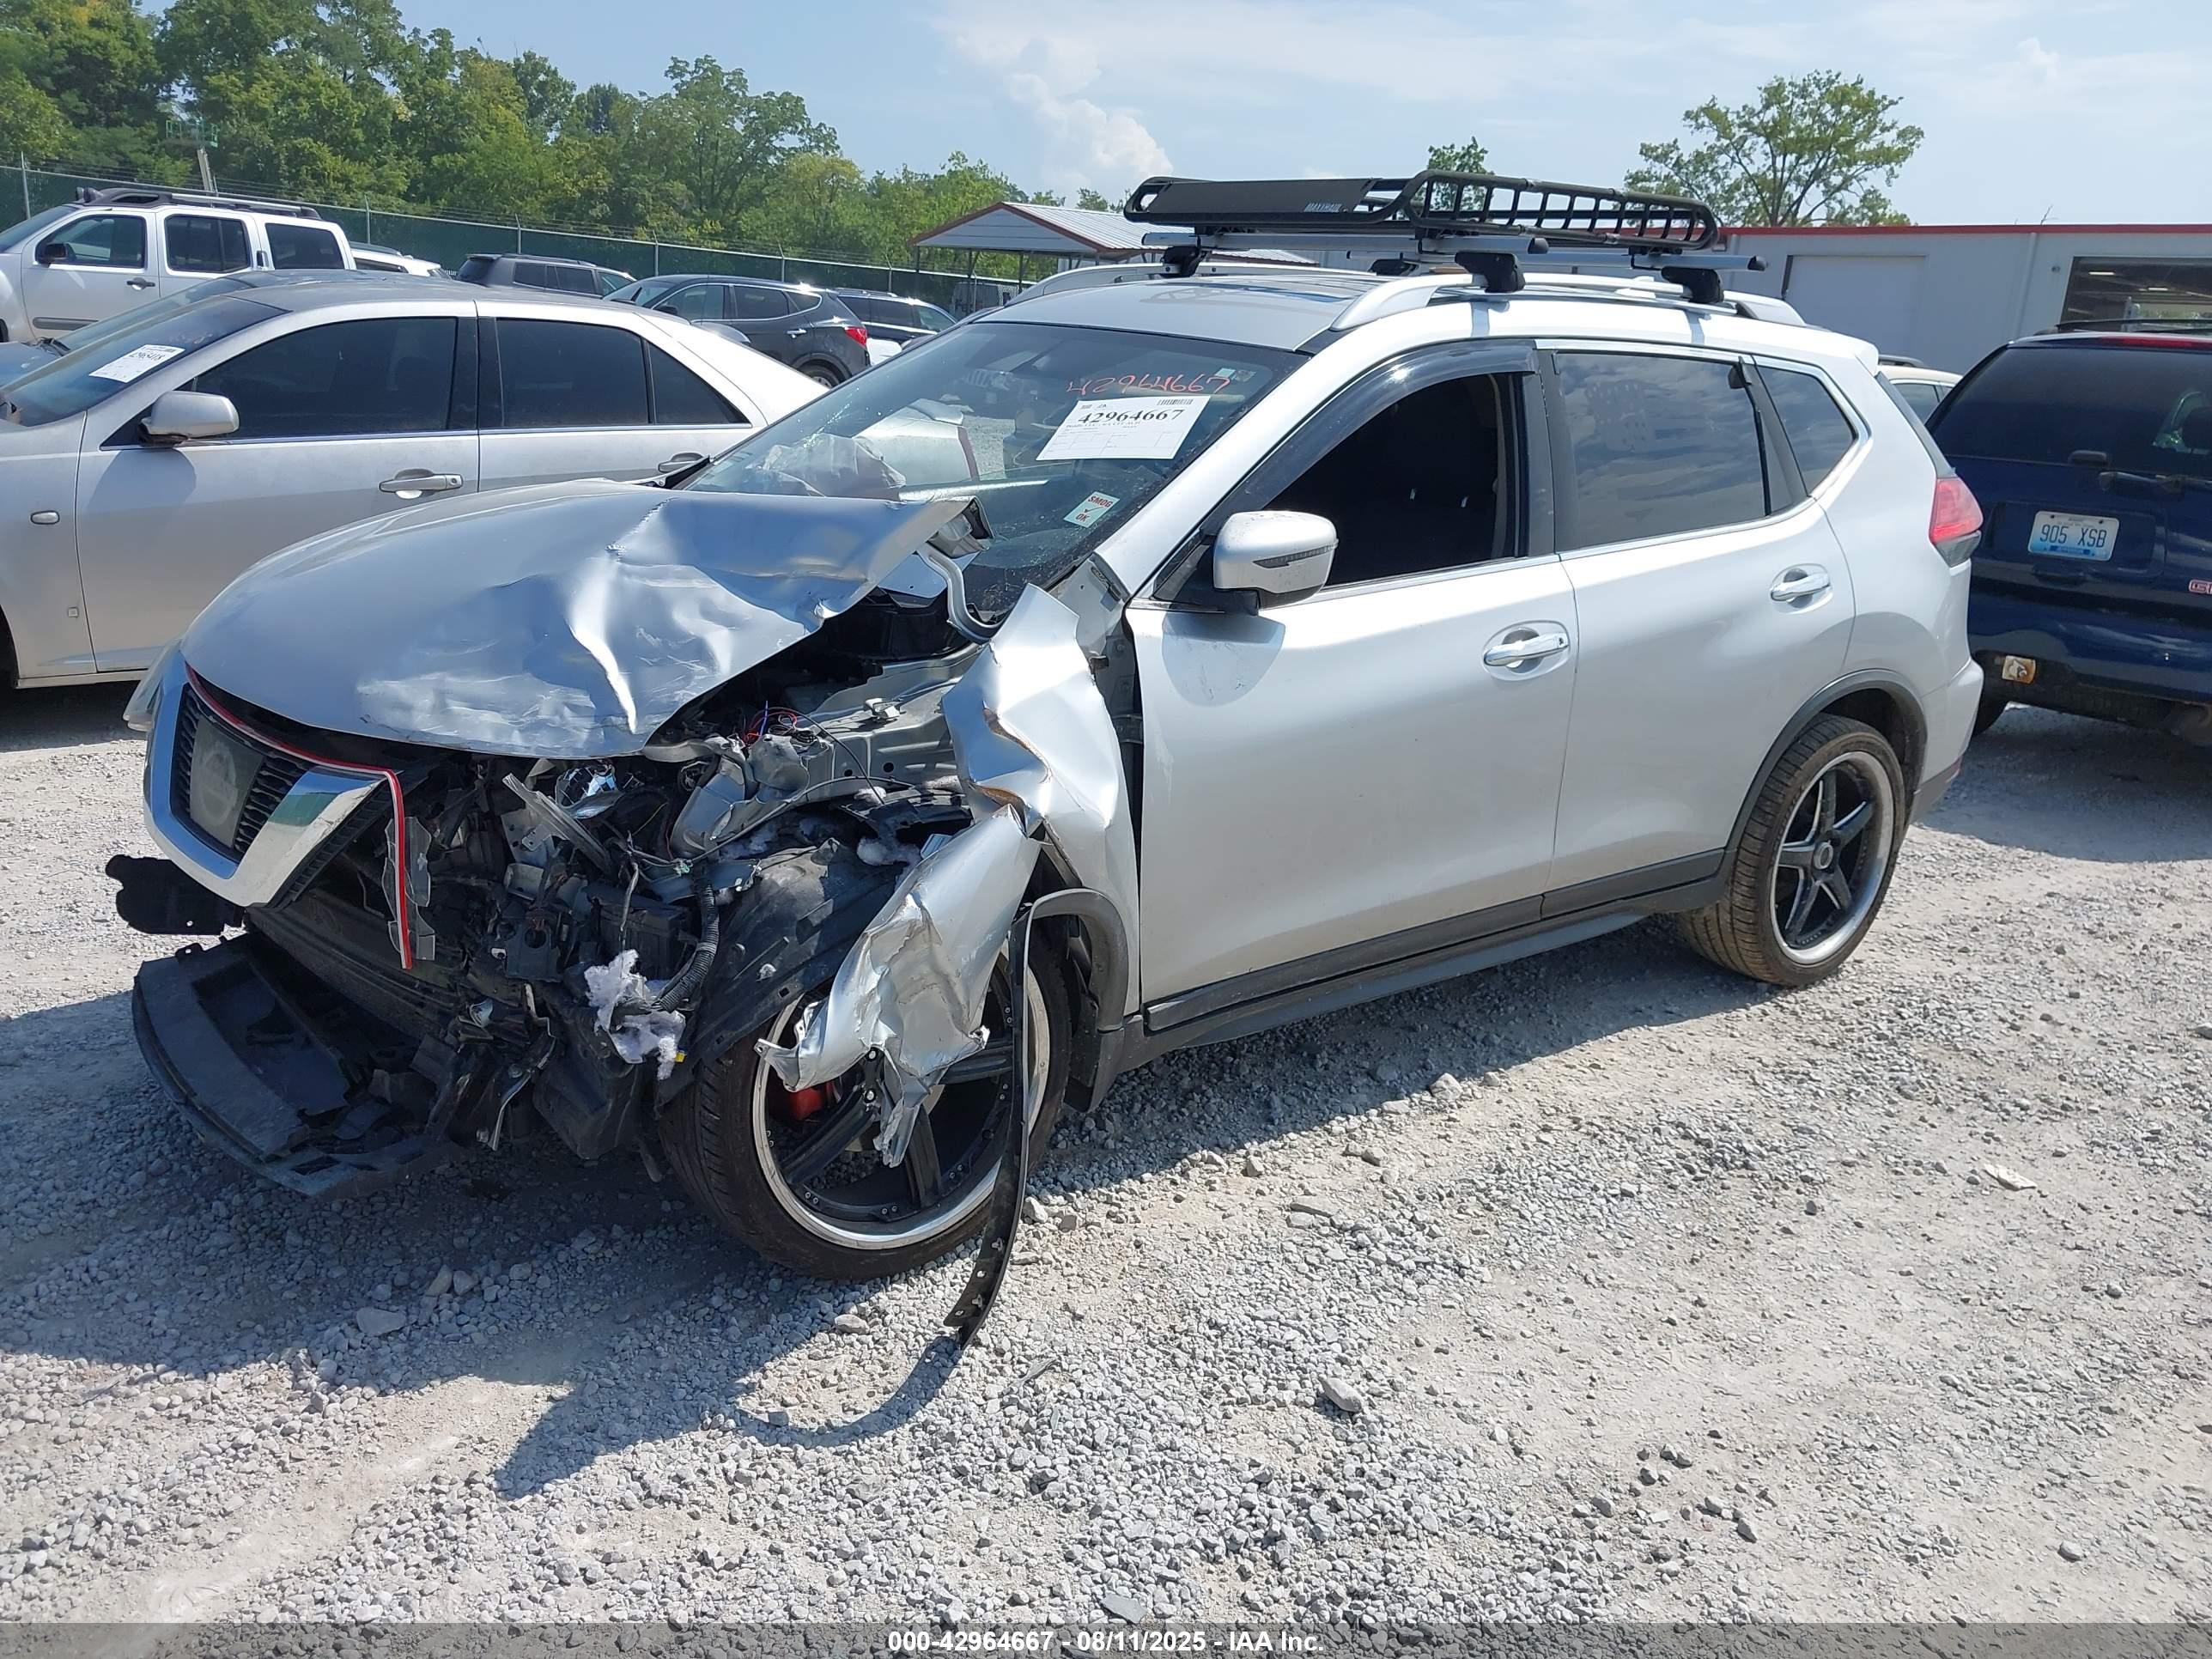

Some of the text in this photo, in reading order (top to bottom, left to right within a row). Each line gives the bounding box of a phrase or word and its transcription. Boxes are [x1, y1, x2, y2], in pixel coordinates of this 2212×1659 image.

[1066, 374, 1231, 395] 42964667
[1078, 409, 1186, 423] 42964667
[1088, 495, 1114, 508] SMOG
[1075, 514, 1091, 522] OK
[2039, 524, 2107, 548] 905 XSB
